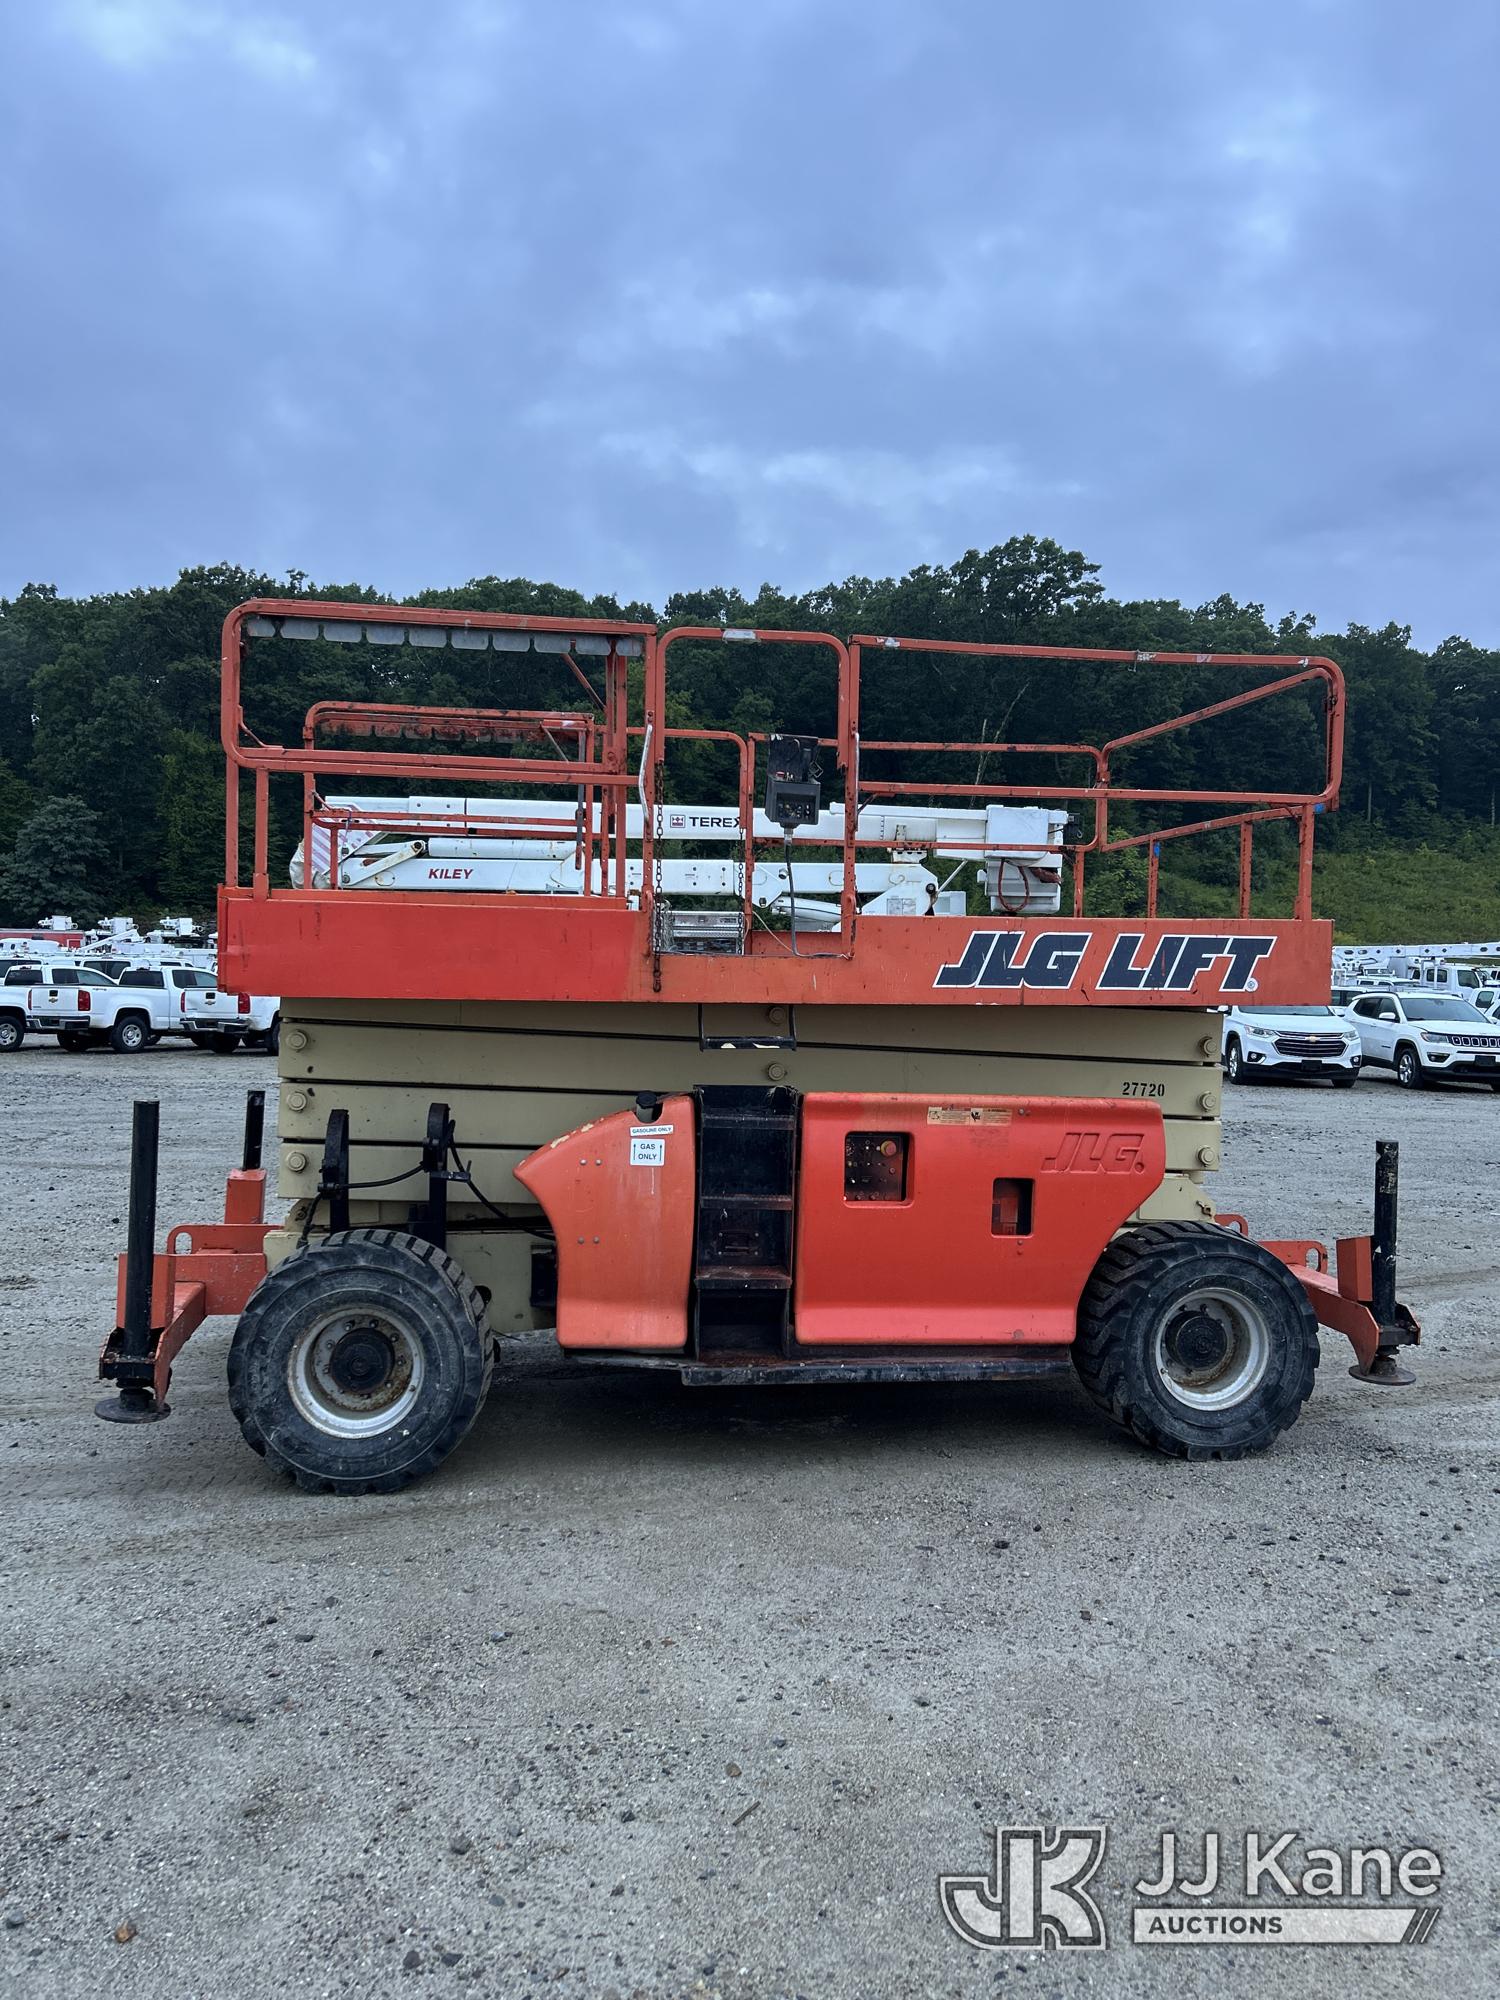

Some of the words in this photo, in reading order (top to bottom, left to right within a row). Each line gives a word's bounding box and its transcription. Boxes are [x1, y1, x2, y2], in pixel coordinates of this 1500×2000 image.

[428, 868, 473, 879] KILEY
[933, 931, 1093, 989] JLG
[1095, 933, 1277, 992] LIFT
[1122, 1082, 1165, 1097] 27720
